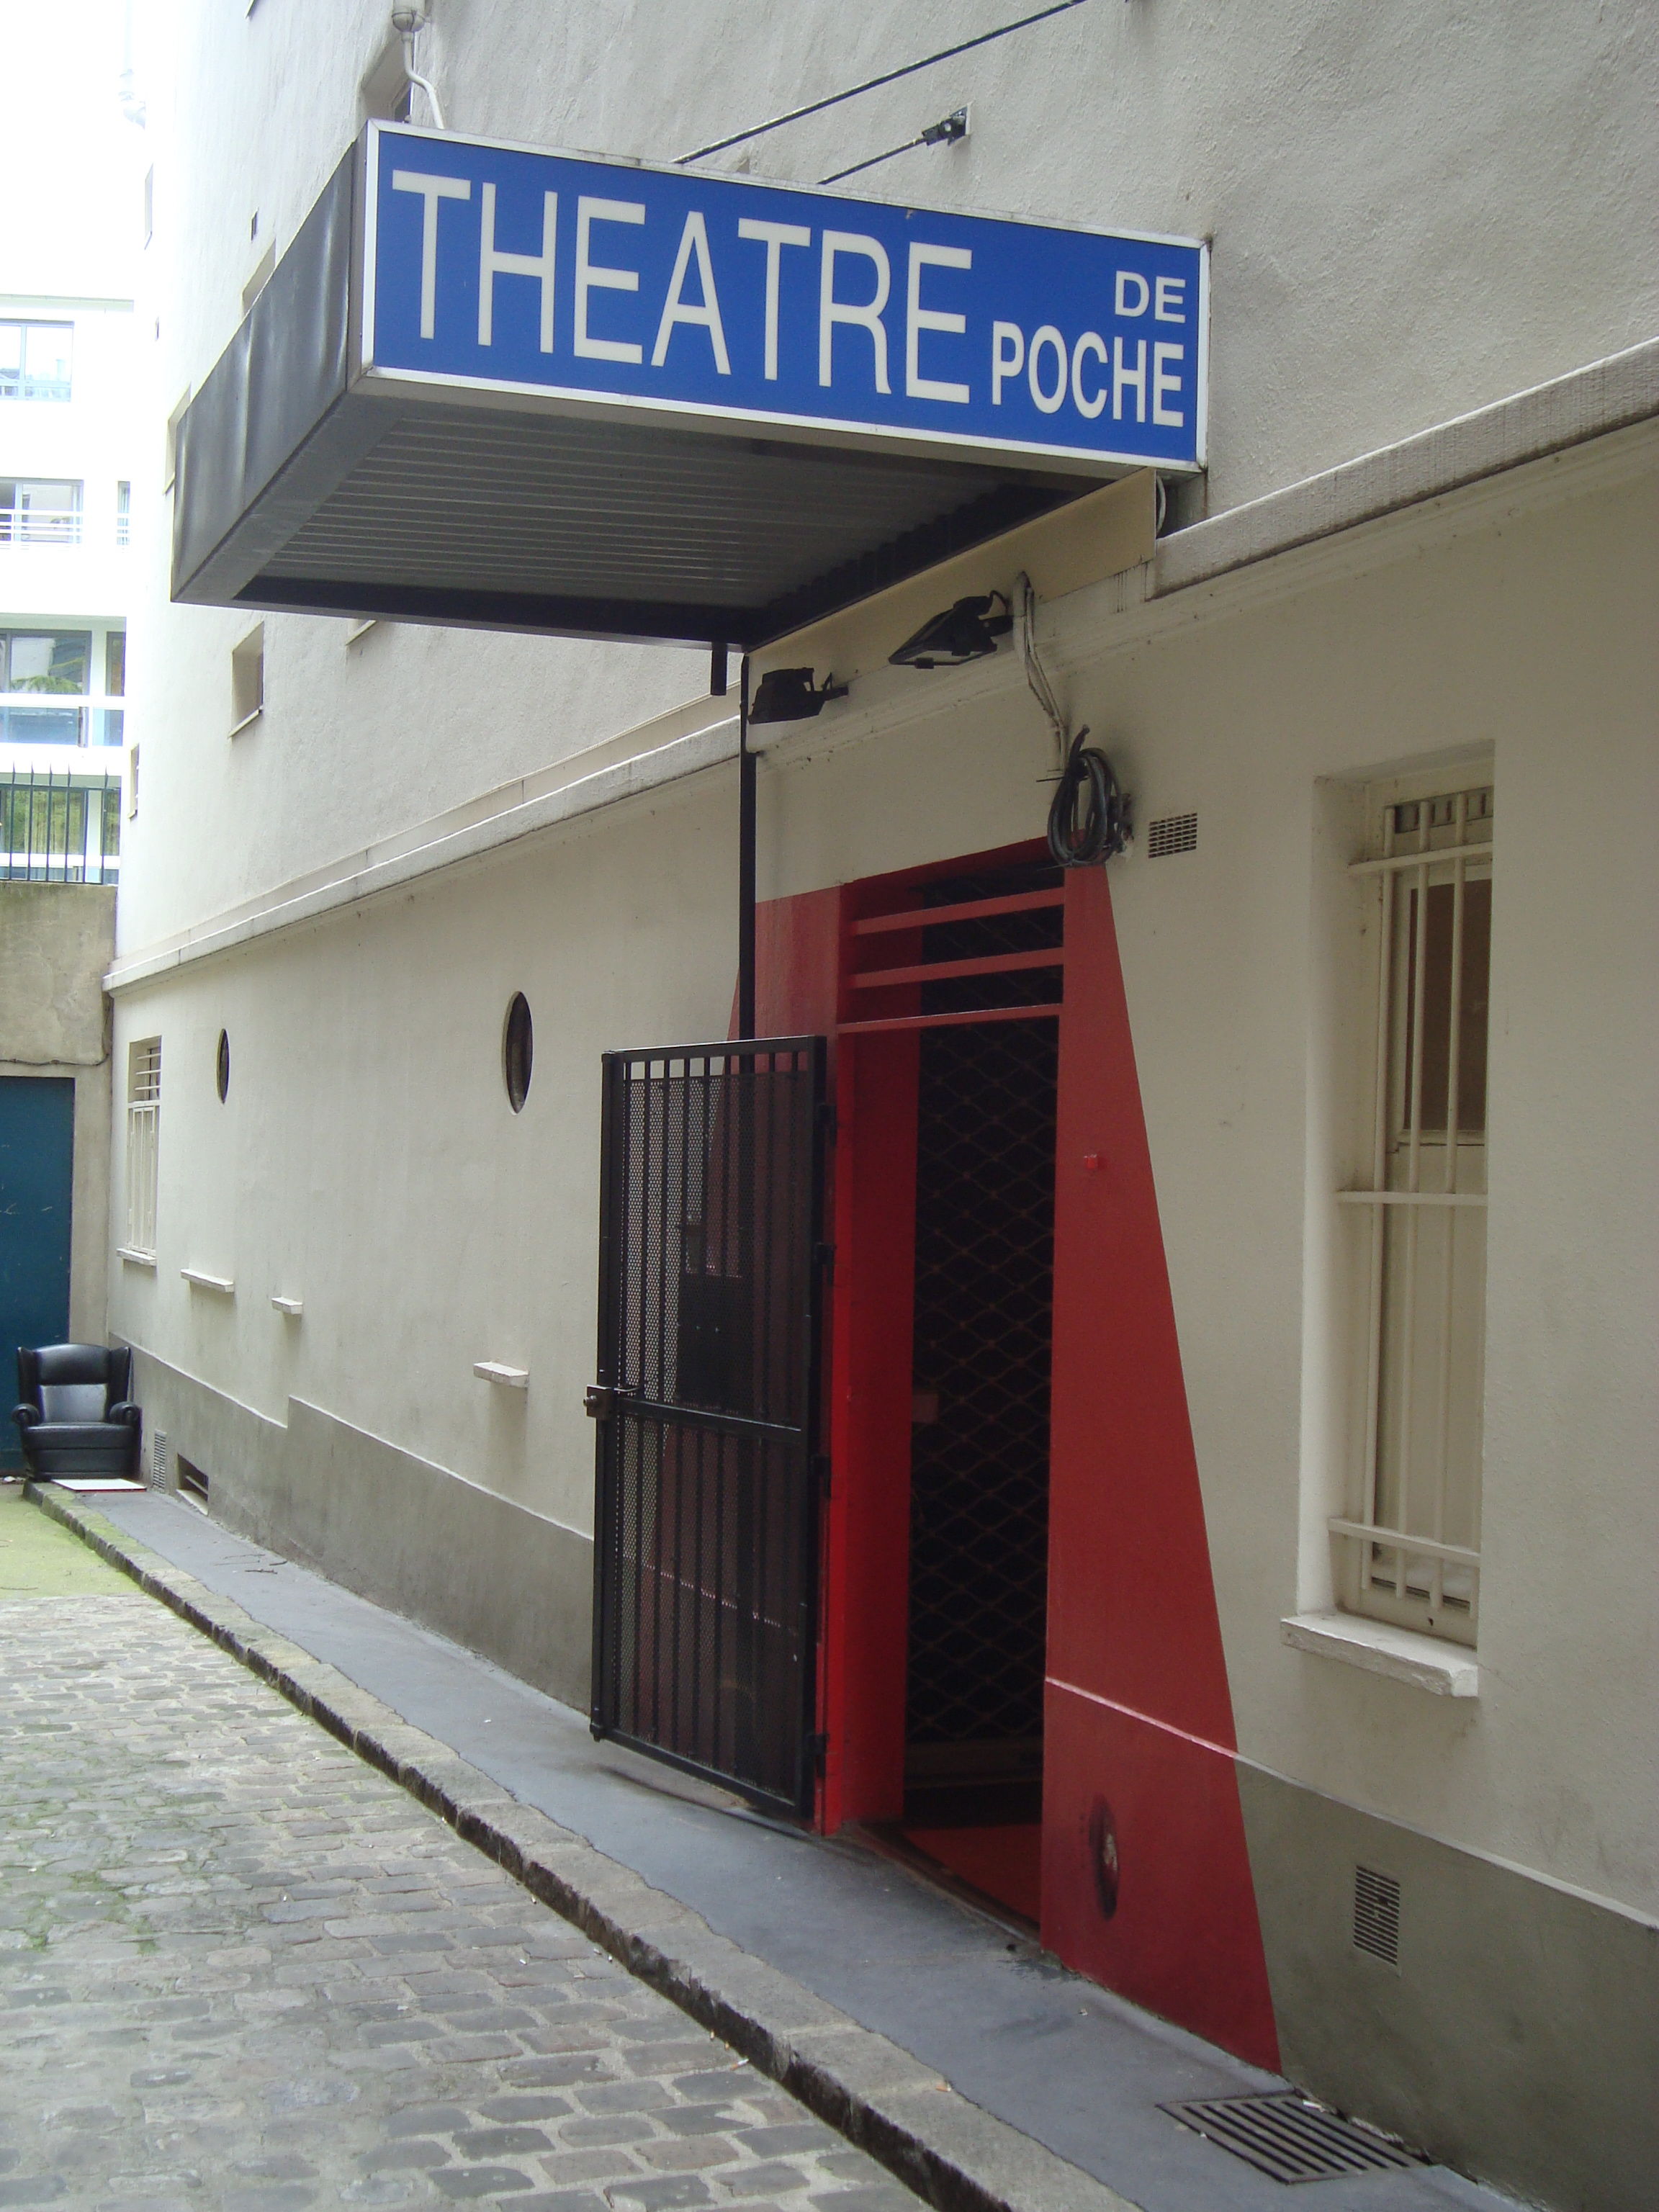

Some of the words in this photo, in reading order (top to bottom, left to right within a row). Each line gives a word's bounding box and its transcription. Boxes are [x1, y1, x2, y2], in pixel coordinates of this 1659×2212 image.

[392, 169, 971, 404] THEATRE
[1115, 271, 1186, 323] DE
[992, 320, 1184, 428] POCHE
